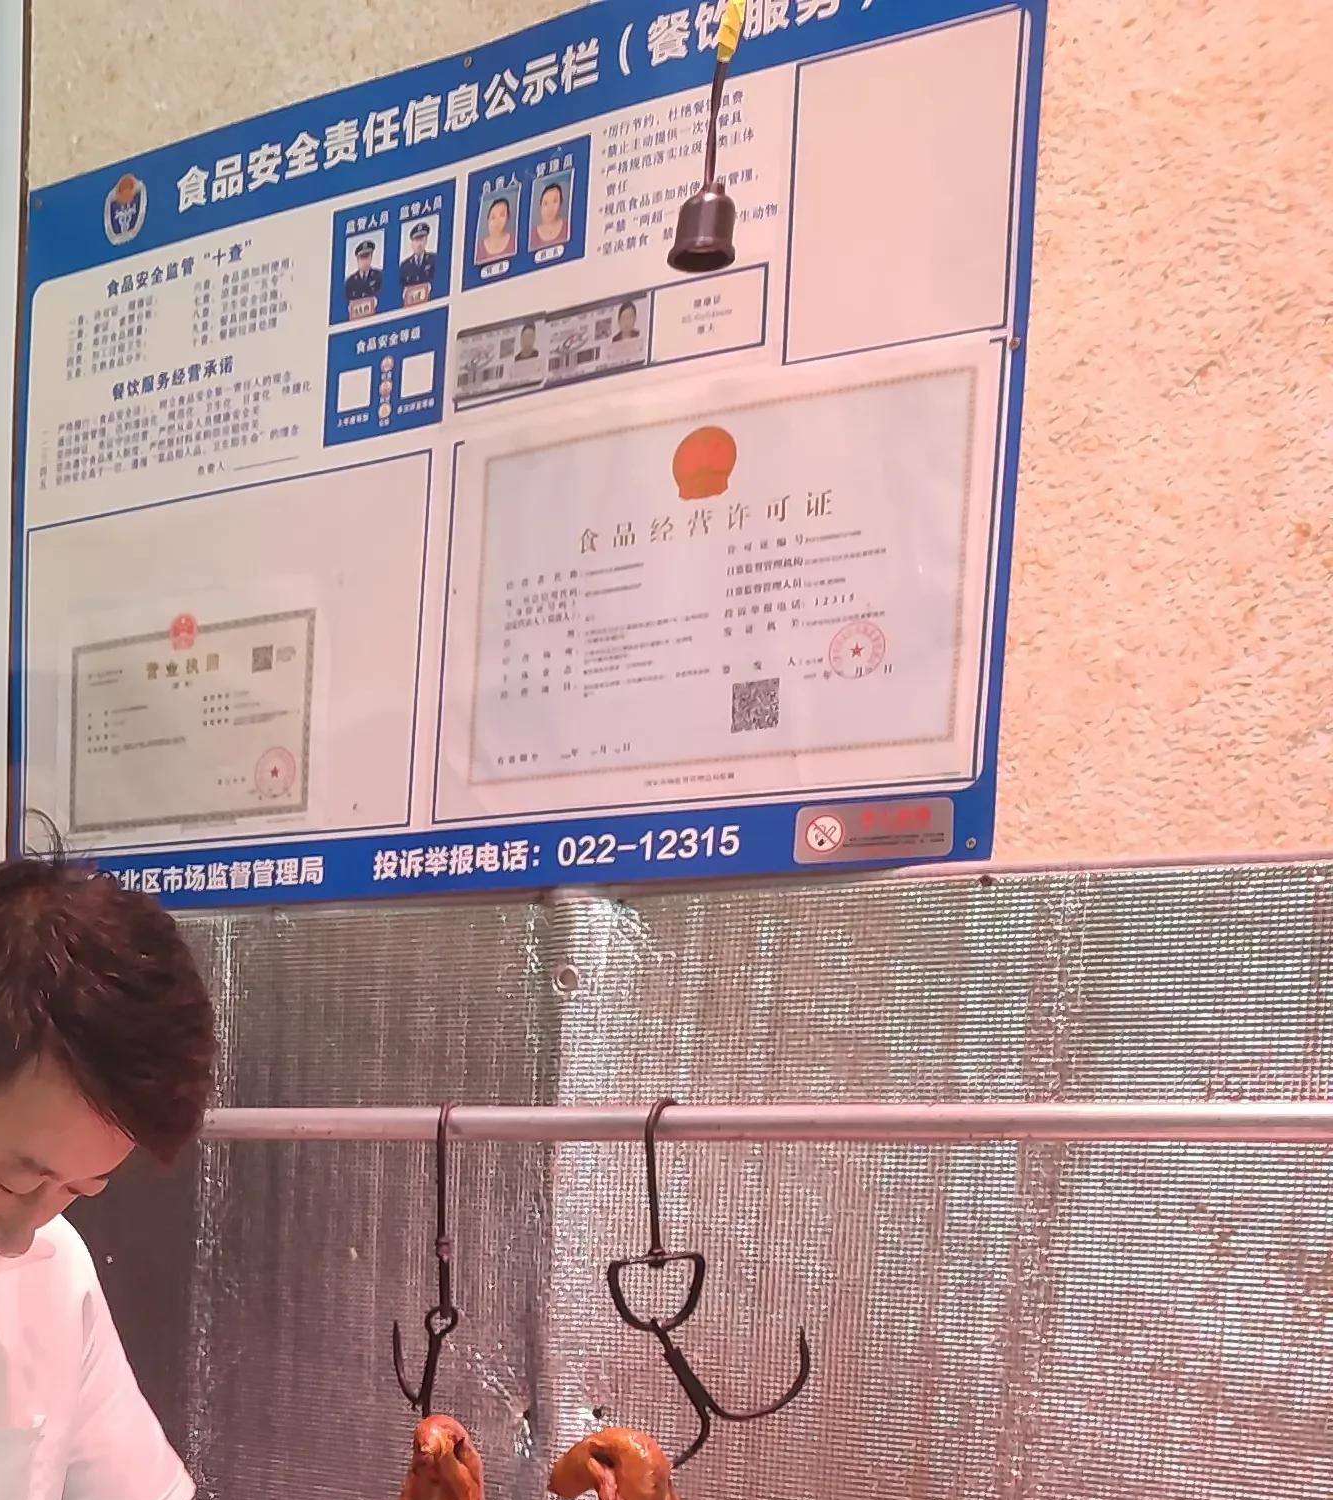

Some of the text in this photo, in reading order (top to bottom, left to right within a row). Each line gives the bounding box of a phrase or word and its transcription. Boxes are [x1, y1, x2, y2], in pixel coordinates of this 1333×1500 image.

[177, 0, 873, 213] 食品安全责任信息公示栏（餐饮服务
[112, 355, 234, 402] 餐饮服务经营承诺
[580, 489, 833, 554] 食品经营许可证
[145, 653, 220, 681] 营业执照
